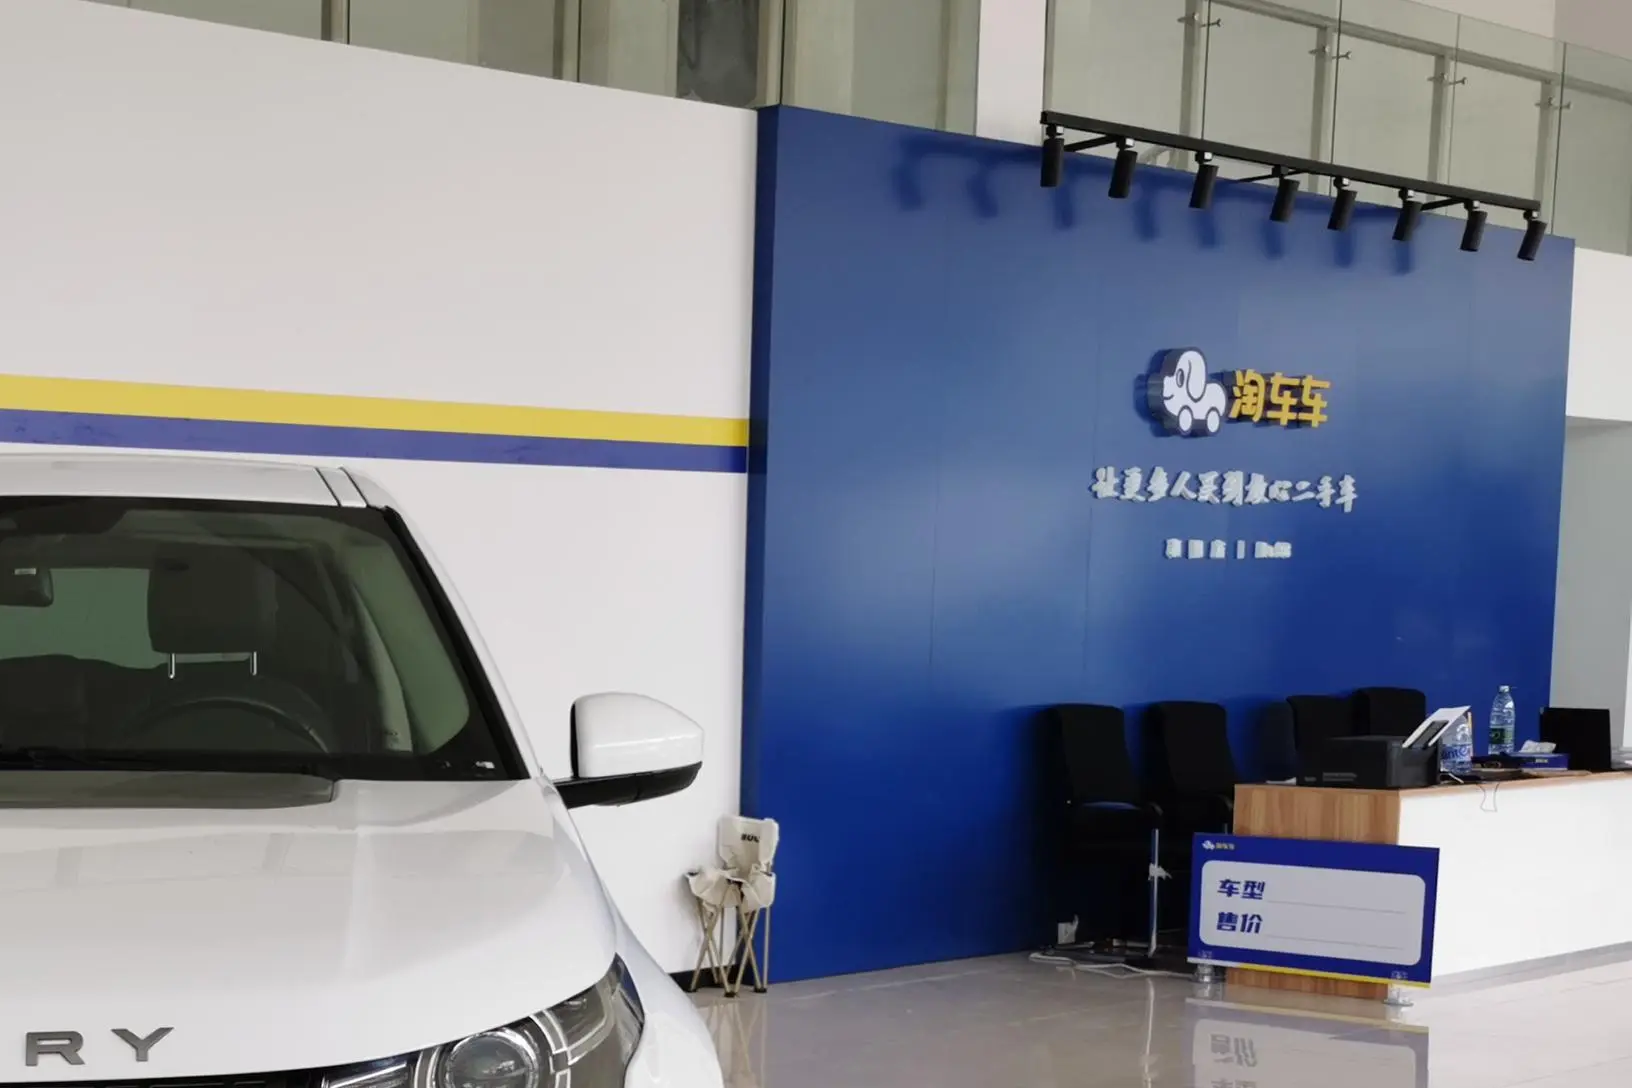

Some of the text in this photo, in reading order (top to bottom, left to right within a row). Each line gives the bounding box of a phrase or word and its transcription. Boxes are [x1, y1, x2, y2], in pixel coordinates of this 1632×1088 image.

[1227, 368, 1331, 428] 淘车车
[1217, 878, 1266, 900] 车型
[1216, 911, 1264, 934] 售价
